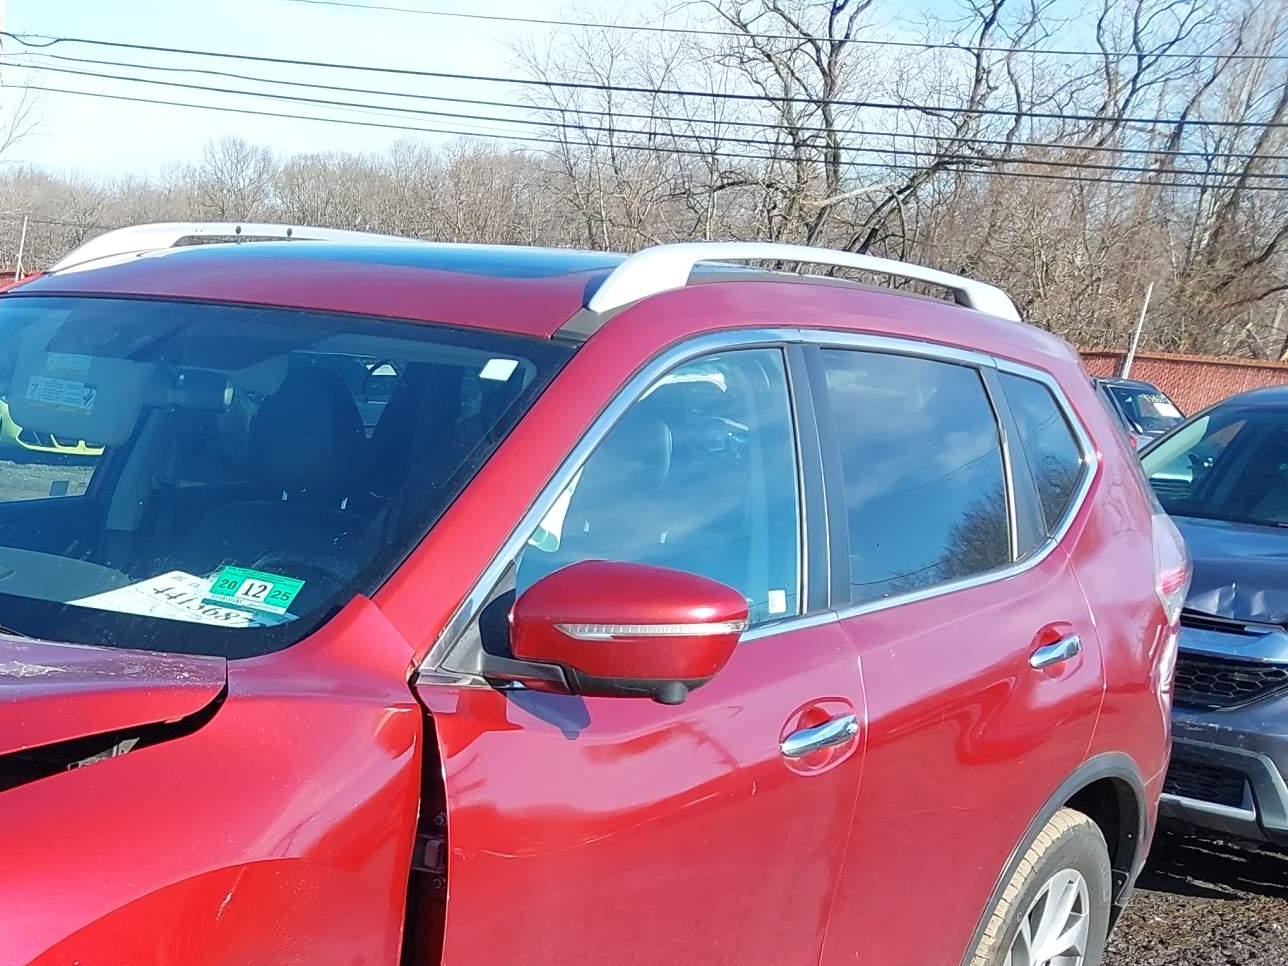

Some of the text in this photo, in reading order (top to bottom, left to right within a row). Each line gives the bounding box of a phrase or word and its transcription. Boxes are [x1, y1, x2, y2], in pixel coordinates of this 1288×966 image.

[219, 579, 292, 601] 20 12 25
